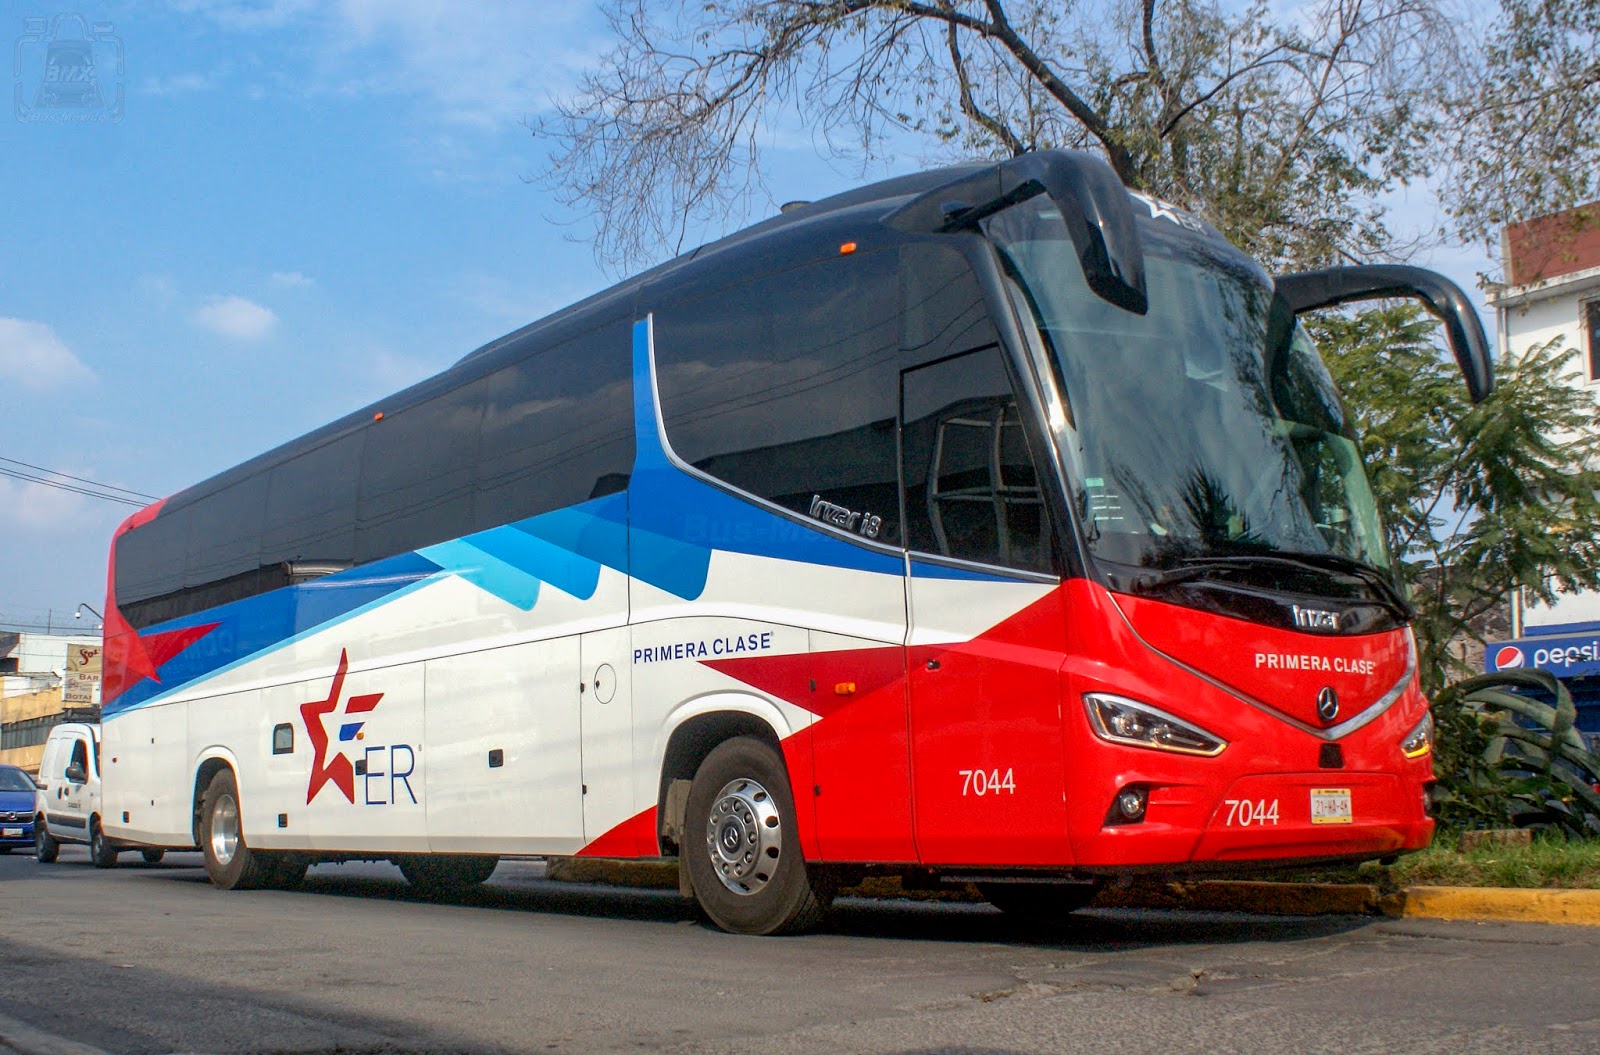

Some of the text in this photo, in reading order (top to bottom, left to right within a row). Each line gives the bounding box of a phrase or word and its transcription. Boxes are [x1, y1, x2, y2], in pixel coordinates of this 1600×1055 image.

[860, 512, 881, 538] i8
[634, 632, 772, 664] PRIMERA CLASE
[1534, 640, 1598, 668] pepsi
[1255, 653, 1373, 675] PRIMERA CLASE
[365, 744, 418, 805] ER
[958, 768, 1017, 796] 7044
[1225, 799, 1280, 826] 7044
